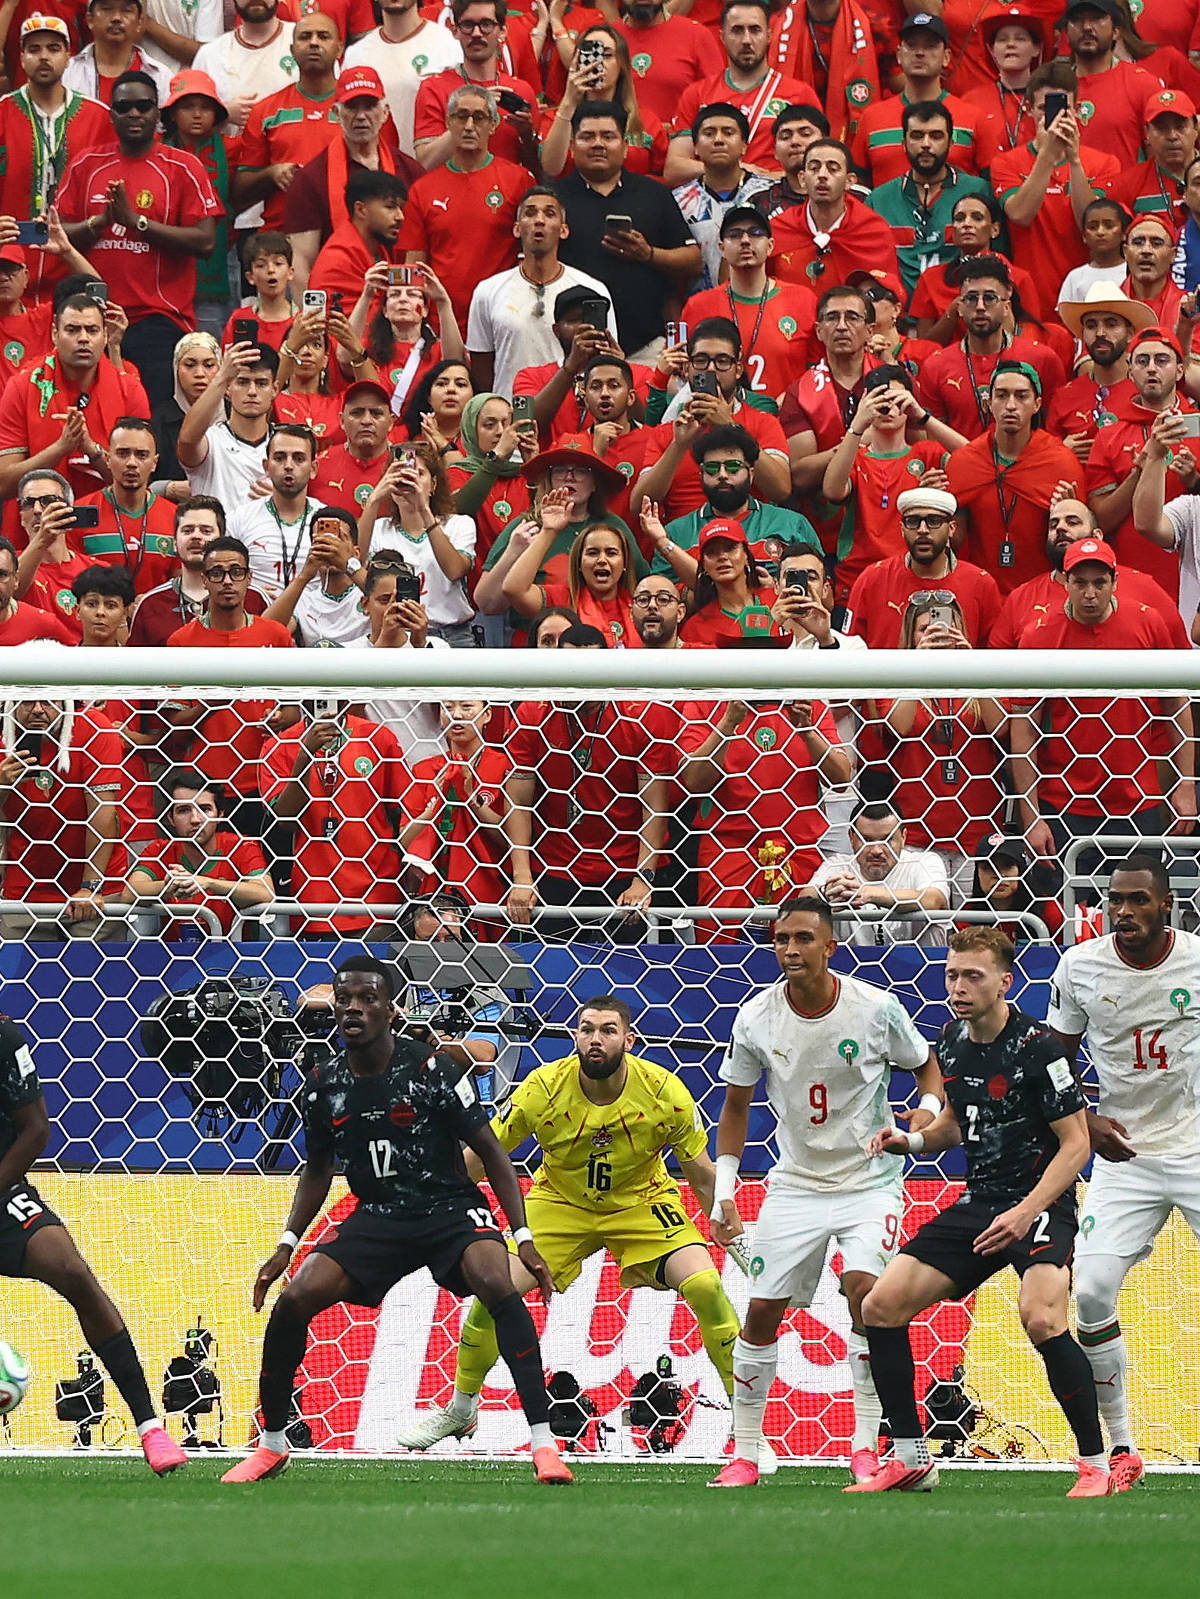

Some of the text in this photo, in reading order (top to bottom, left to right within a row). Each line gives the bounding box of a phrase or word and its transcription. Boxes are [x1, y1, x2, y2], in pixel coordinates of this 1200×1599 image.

[748, 354, 767, 391] 2
[1132, 1028, 1168, 1071] 14
[808, 1084, 829, 1126] 9
[965, 1104, 981, 1142] 2
[368, 1139, 398, 1179] 12
[586, 1159, 613, 1192] 16
[6, 1193, 43, 1222] 15
[466, 1206, 499, 1231] 12
[651, 1203, 686, 1230] 16
[880, 1213, 899, 1252] 9
[1034, 1212, 1050, 1243] 2
